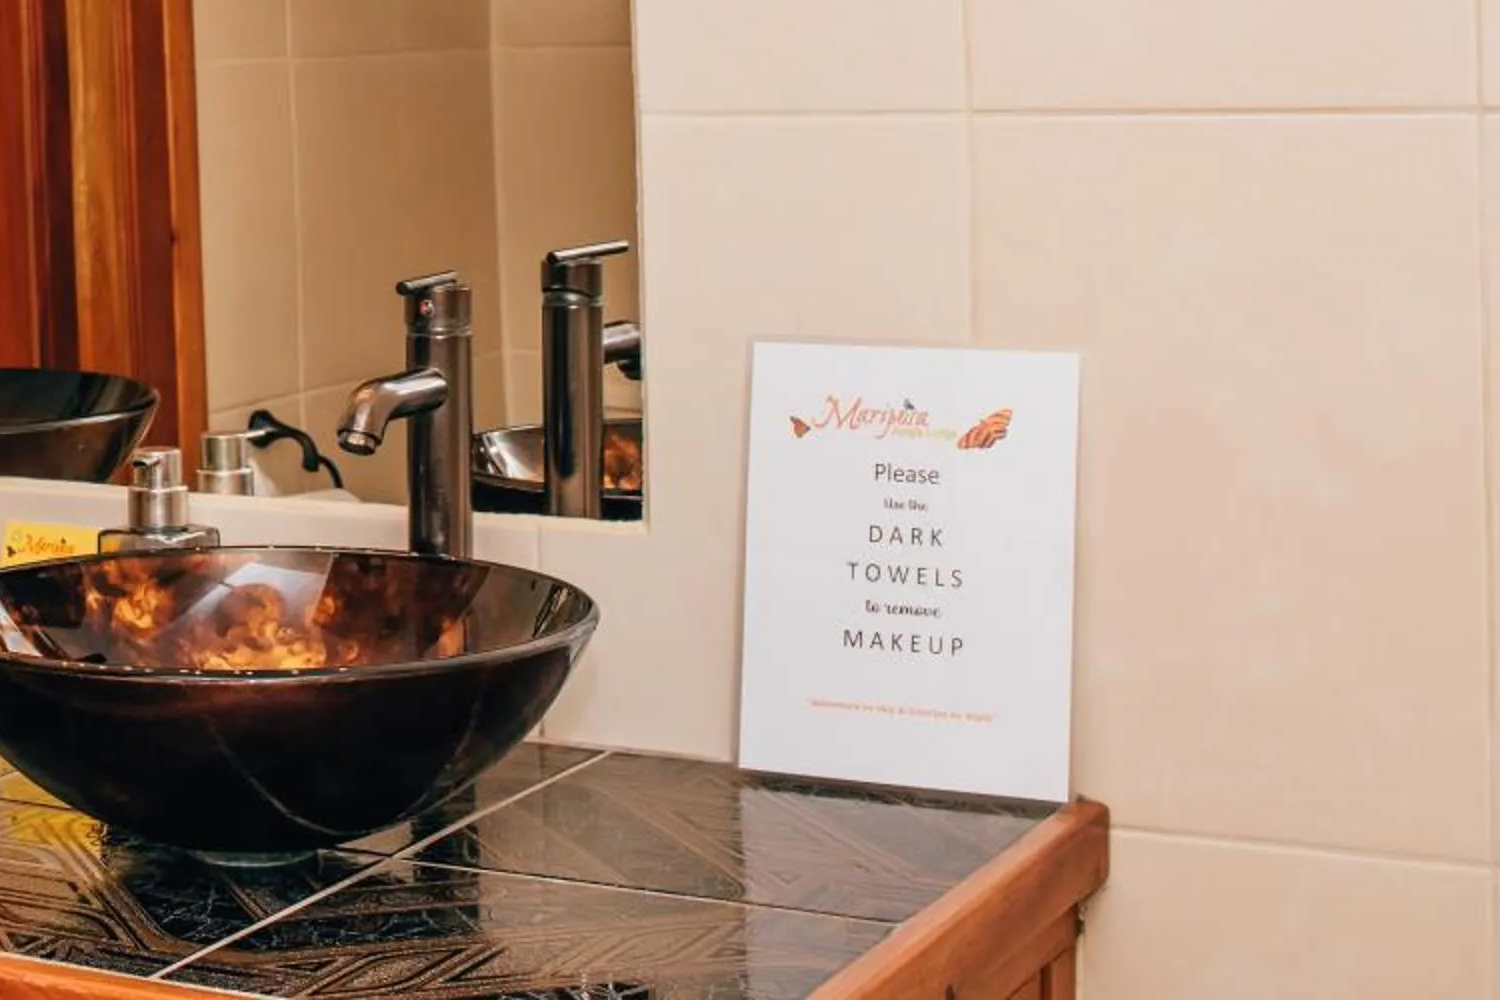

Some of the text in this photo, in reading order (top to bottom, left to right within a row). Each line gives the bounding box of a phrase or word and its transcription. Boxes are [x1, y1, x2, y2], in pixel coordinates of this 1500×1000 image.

[874, 462, 941, 485] Please
[868, 524, 943, 548] DARK
[846, 560, 964, 589] TOWELS
[865, 599, 880, 613] to
[842, 628, 964, 657] MAKEUP
